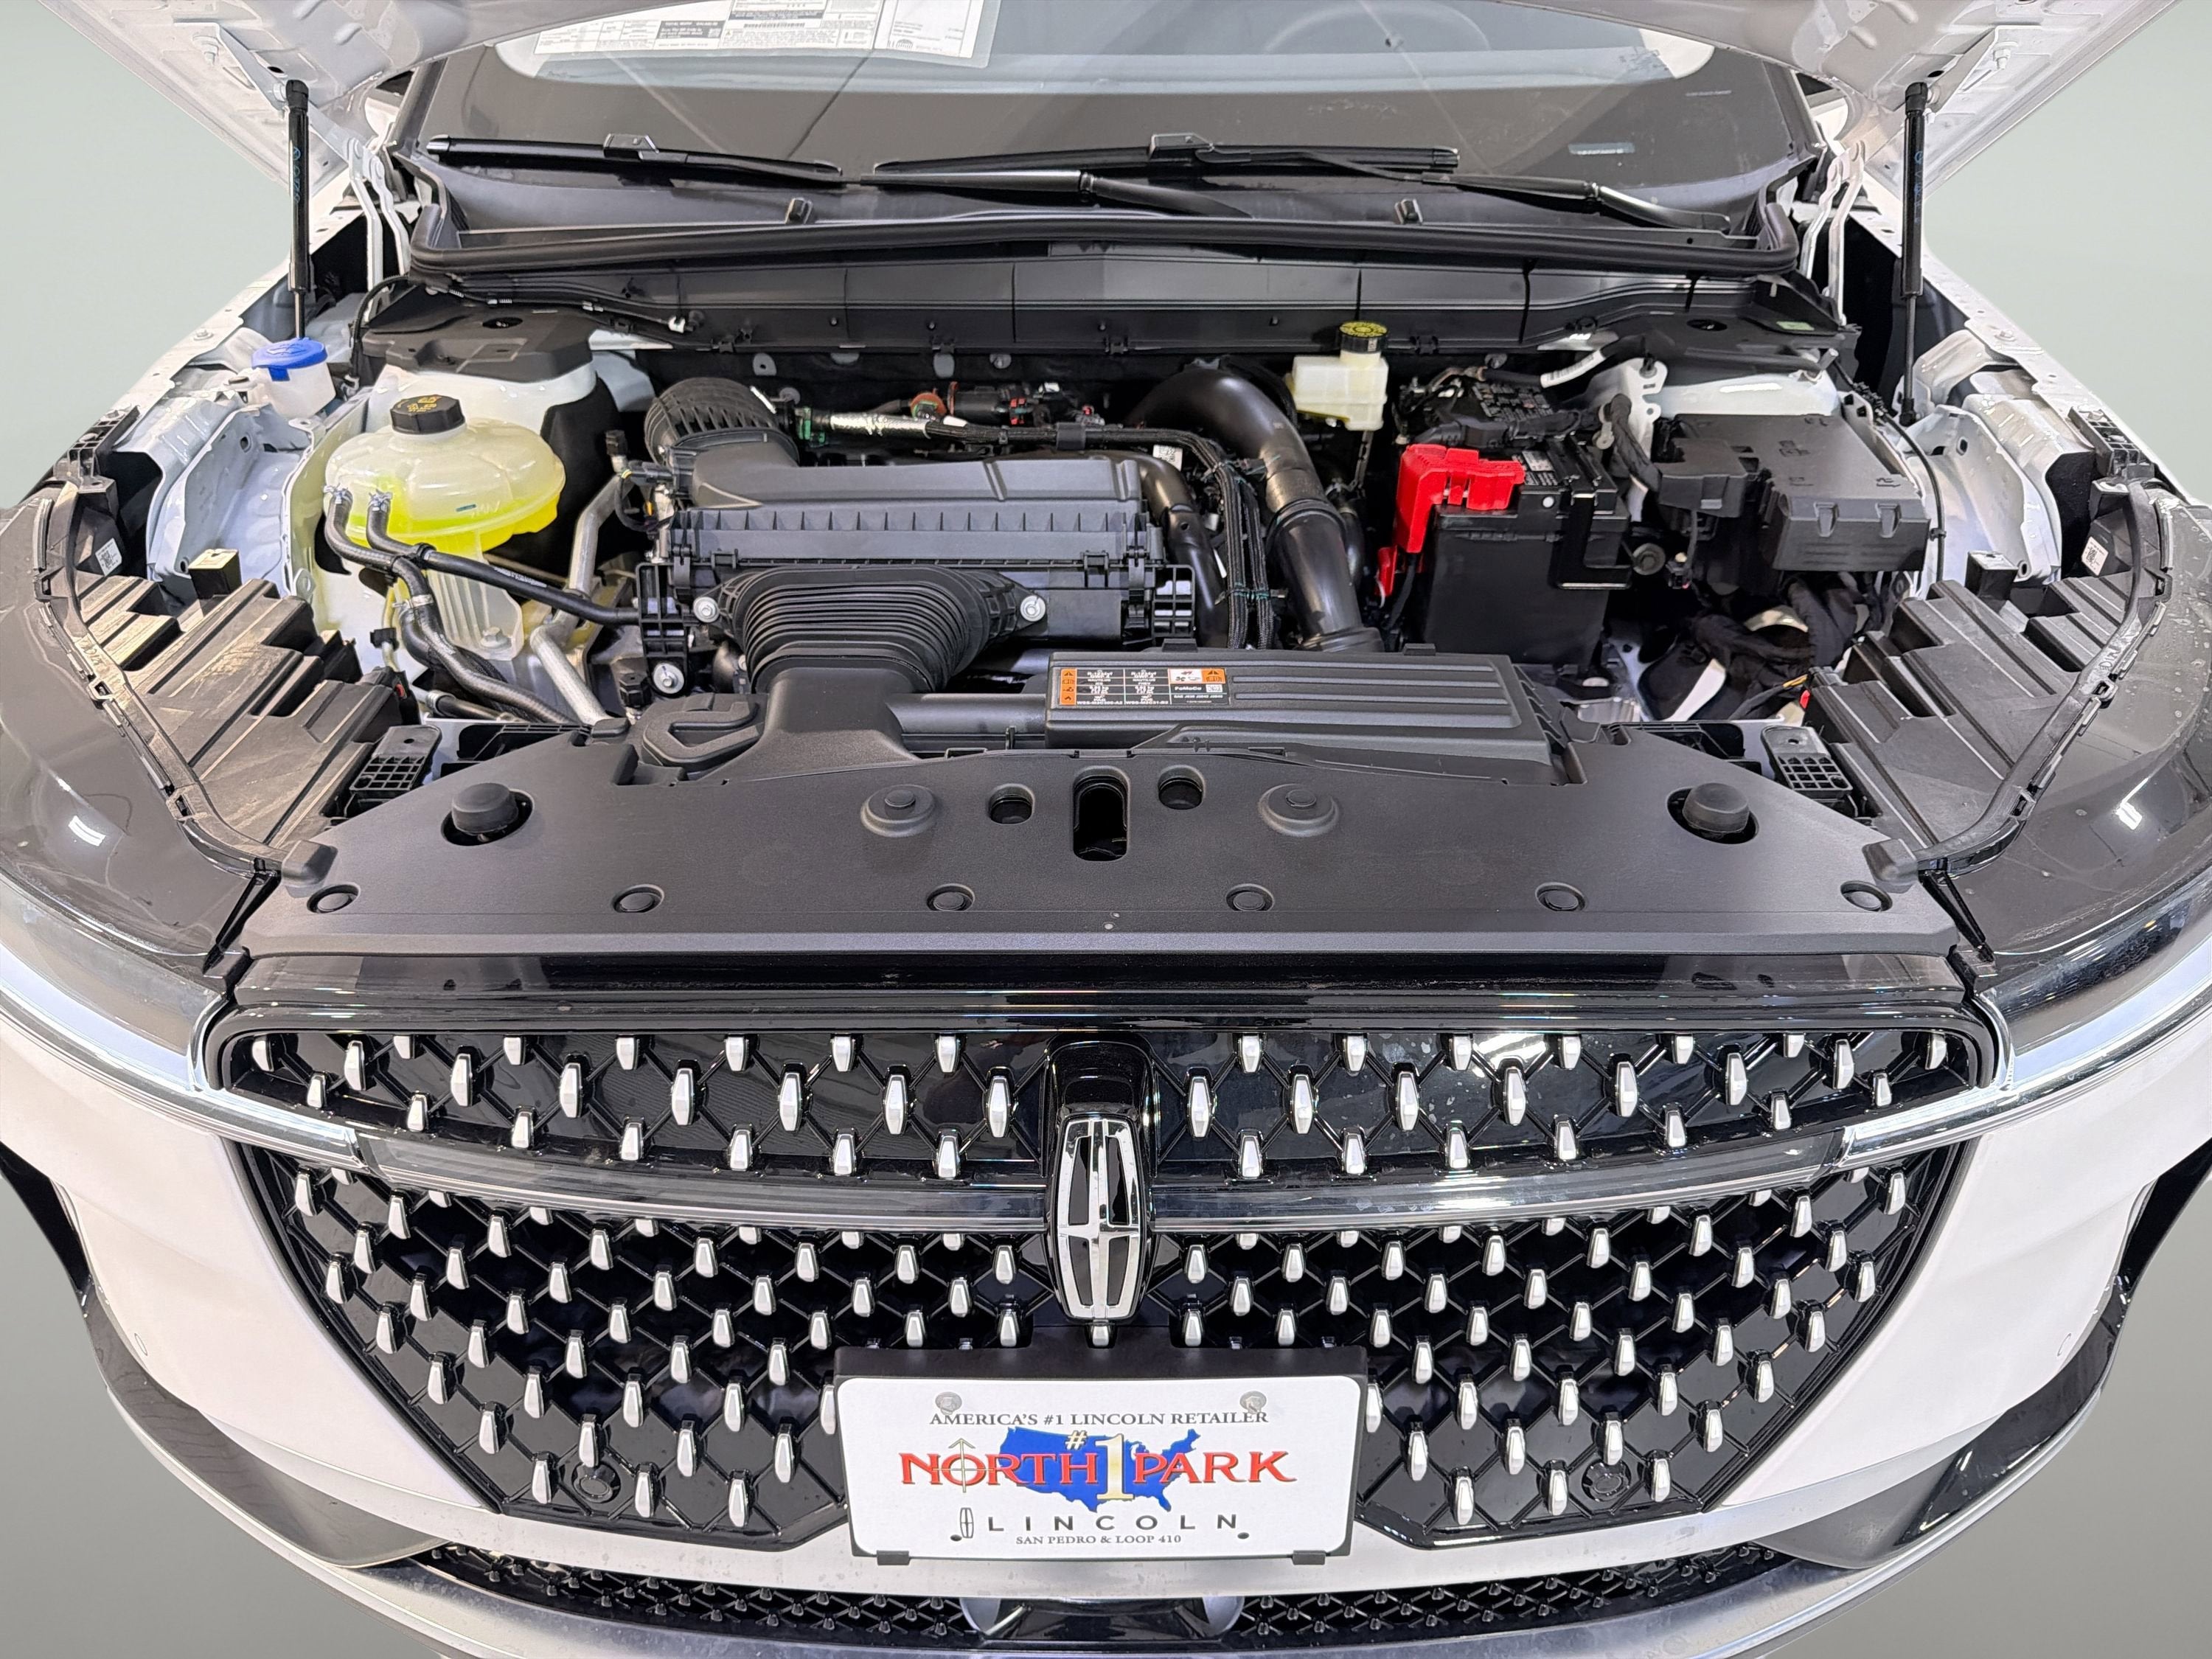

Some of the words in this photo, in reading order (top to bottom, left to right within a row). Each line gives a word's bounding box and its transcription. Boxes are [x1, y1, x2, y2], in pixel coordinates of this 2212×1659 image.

[929, 1413, 1038, 1425] AMERICA'S
[1043, 1414, 1064, 1425] #1
[1070, 1413, 1164, 1425] LINCOLN
[1170, 1412, 1269, 1425] RETAILER
[899, 1452, 1099, 1486] NORTH
[1133, 1450, 1298, 1484] PARK
[987, 1514, 1237, 1531] LINCOLN
[1015, 1536, 1044, 1545] SAN
[1047, 1535, 1096, 1545] PEDRO
[1099, 1535, 1113, 1544] &
[1115, 1535, 1155, 1544] LOOP
[1158, 1534, 1181, 1544] 410
